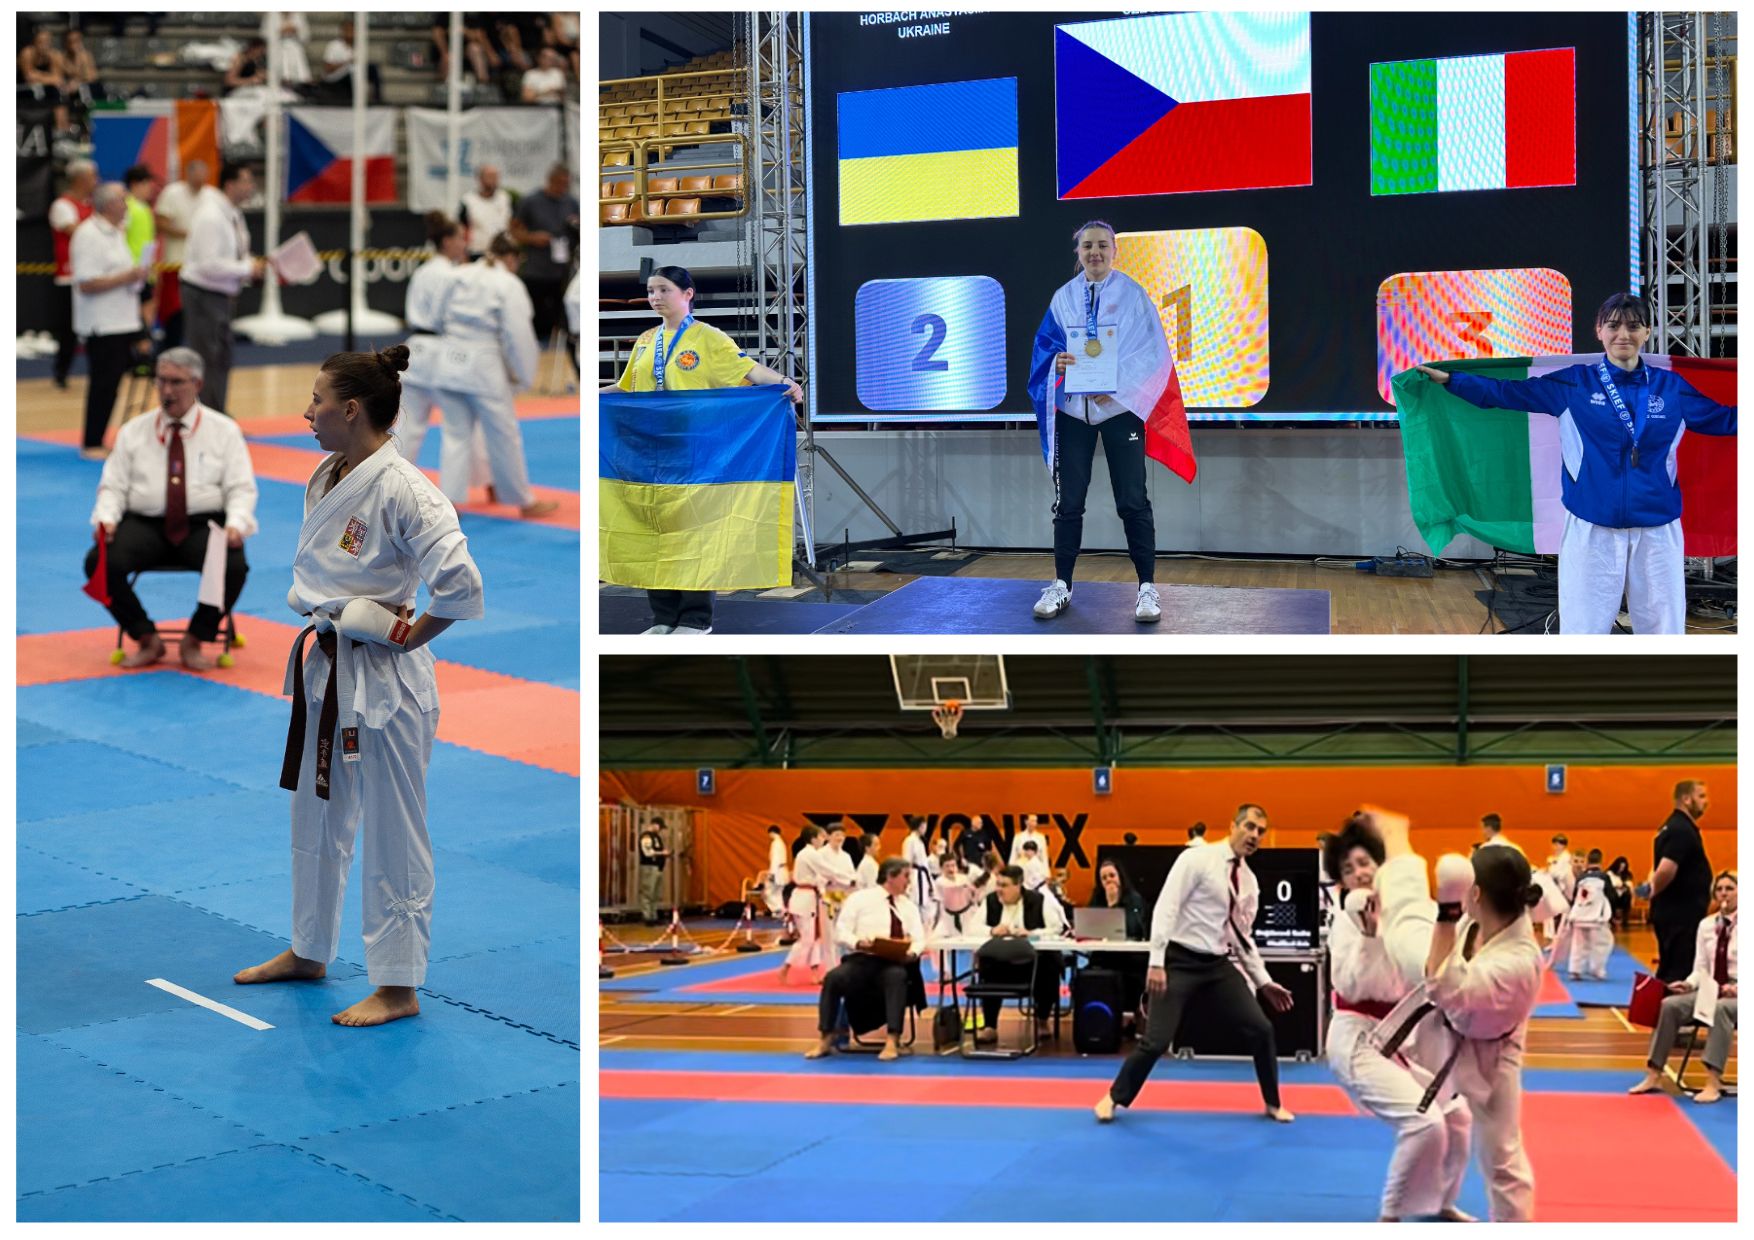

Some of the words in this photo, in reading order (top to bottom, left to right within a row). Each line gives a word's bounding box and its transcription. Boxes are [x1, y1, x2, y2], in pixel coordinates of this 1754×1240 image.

[860, 11, 917, 26] HORBACH
[898, 22, 951, 38] UKRAINE
[1161, 284, 1193, 361] 1
[1449, 311, 1494, 358] 3
[910, 313, 949, 371] 2
[1606, 383, 1626, 410] SKIEF
[702, 775, 710, 787] 7
[1276, 880, 1292, 902] 0
